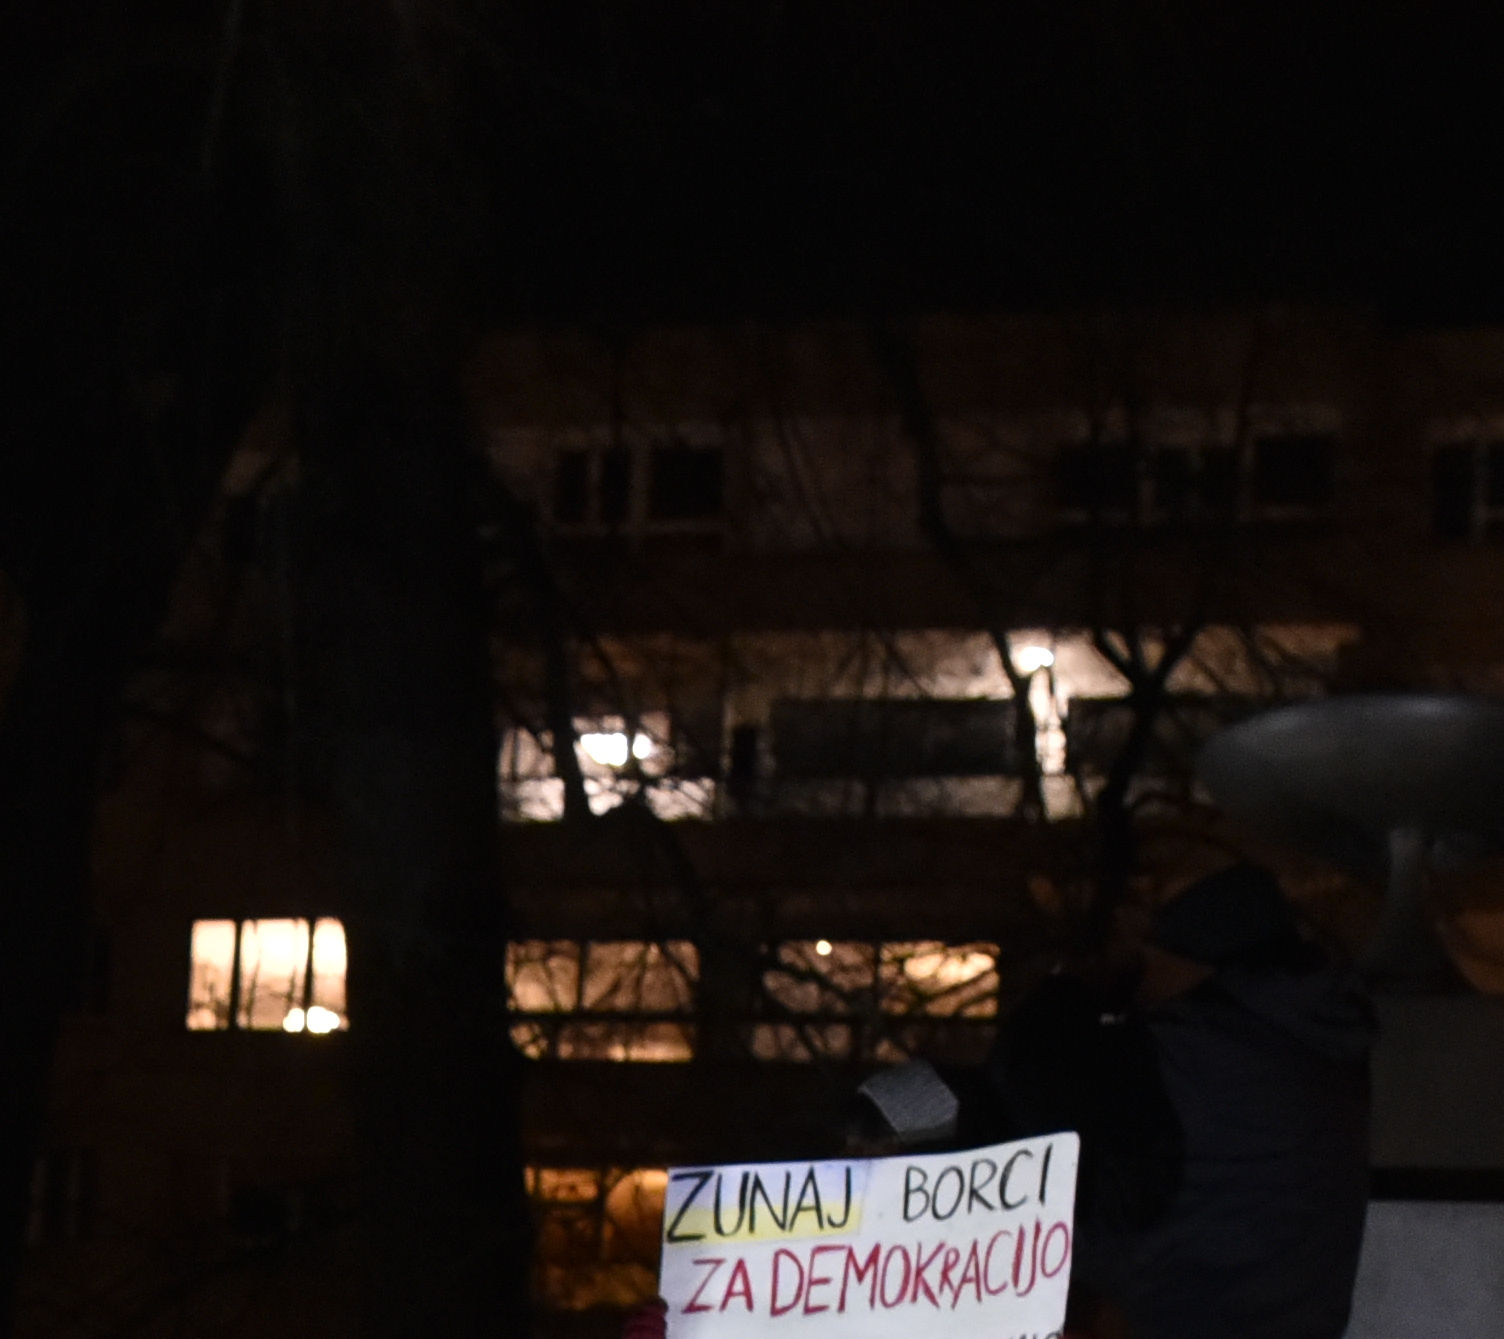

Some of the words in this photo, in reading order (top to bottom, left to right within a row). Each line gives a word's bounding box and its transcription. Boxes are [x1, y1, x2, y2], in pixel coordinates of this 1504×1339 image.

[666, 1165, 853, 1243] ZUNAJ
[903, 1144, 1054, 1222] BORCI
[682, 1257, 755, 1316] ZA
[771, 1220, 1070, 1317] DEMOKRACIJO
